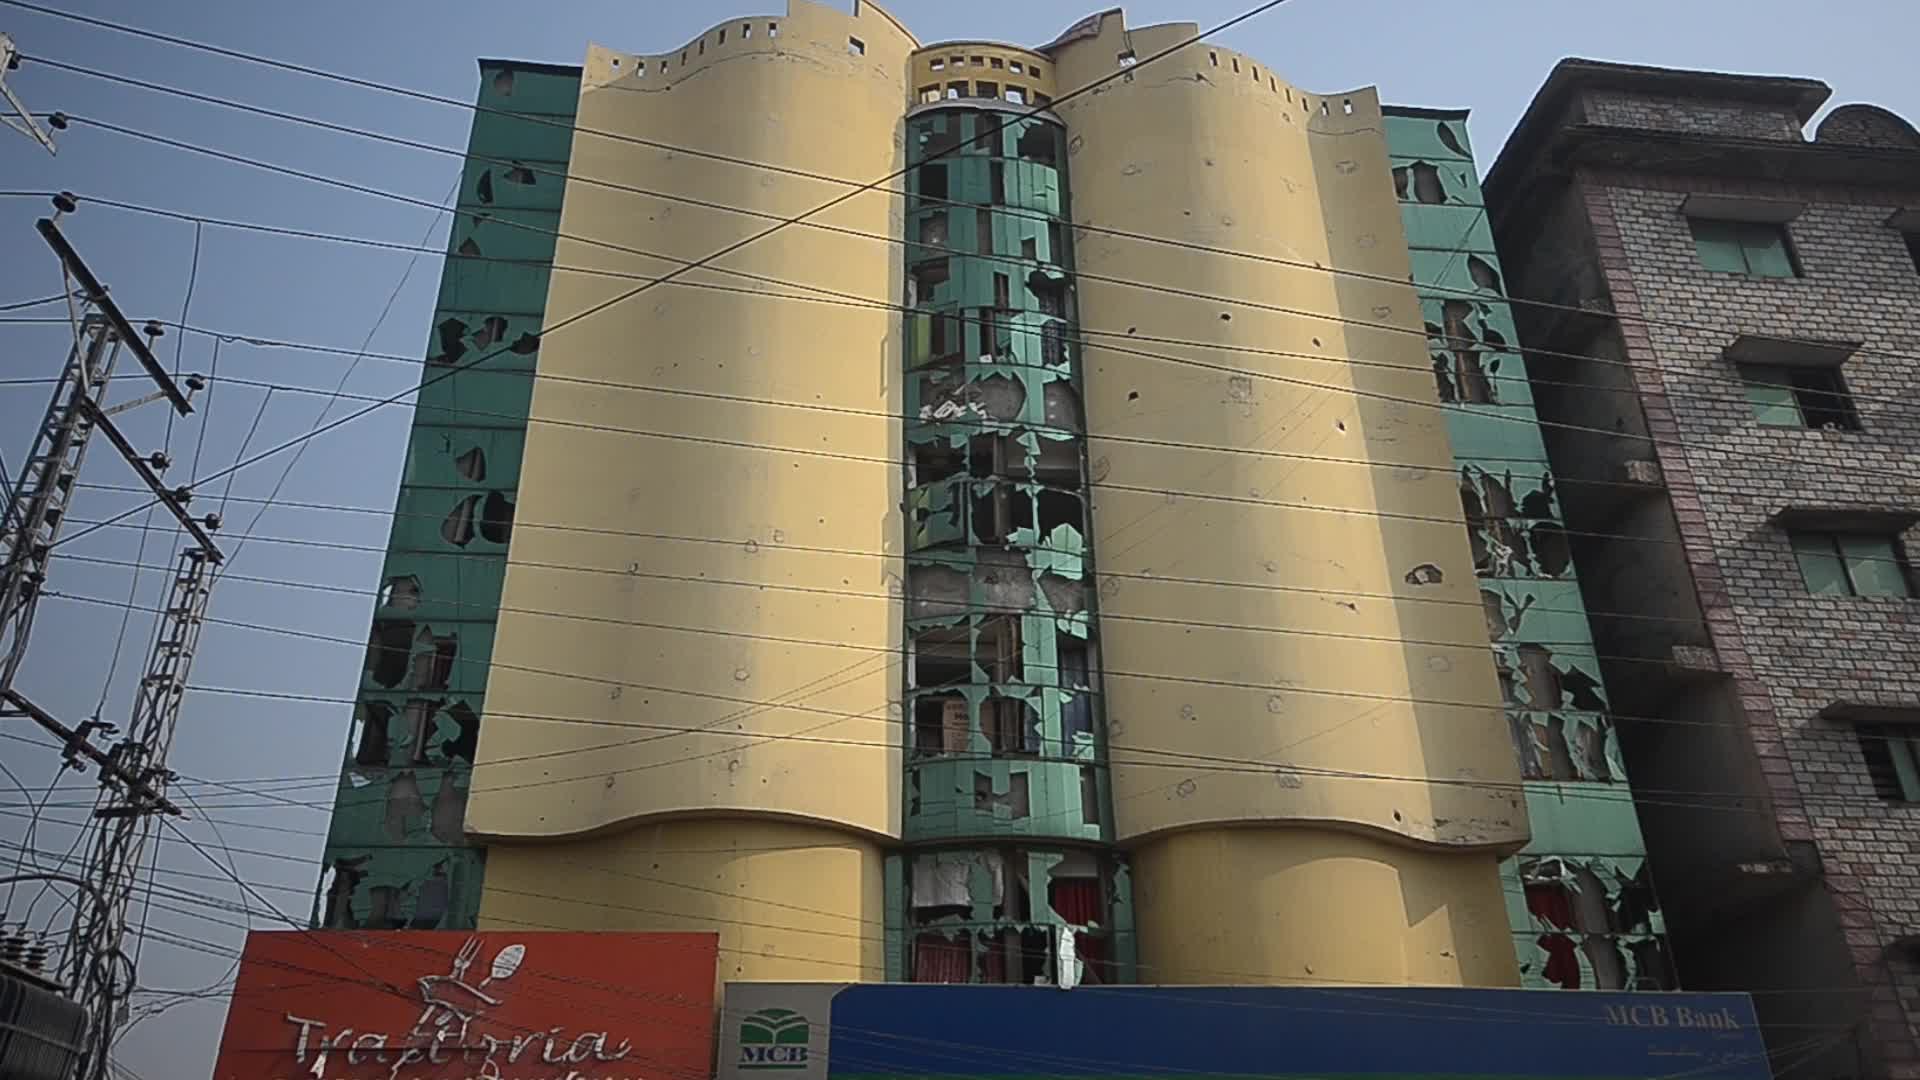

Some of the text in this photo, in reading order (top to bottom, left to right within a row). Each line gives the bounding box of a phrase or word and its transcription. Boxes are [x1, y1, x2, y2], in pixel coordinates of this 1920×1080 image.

[1604, 1005, 1740, 1030] MCB Bank
[740, 1047, 808, 1064] MCB
